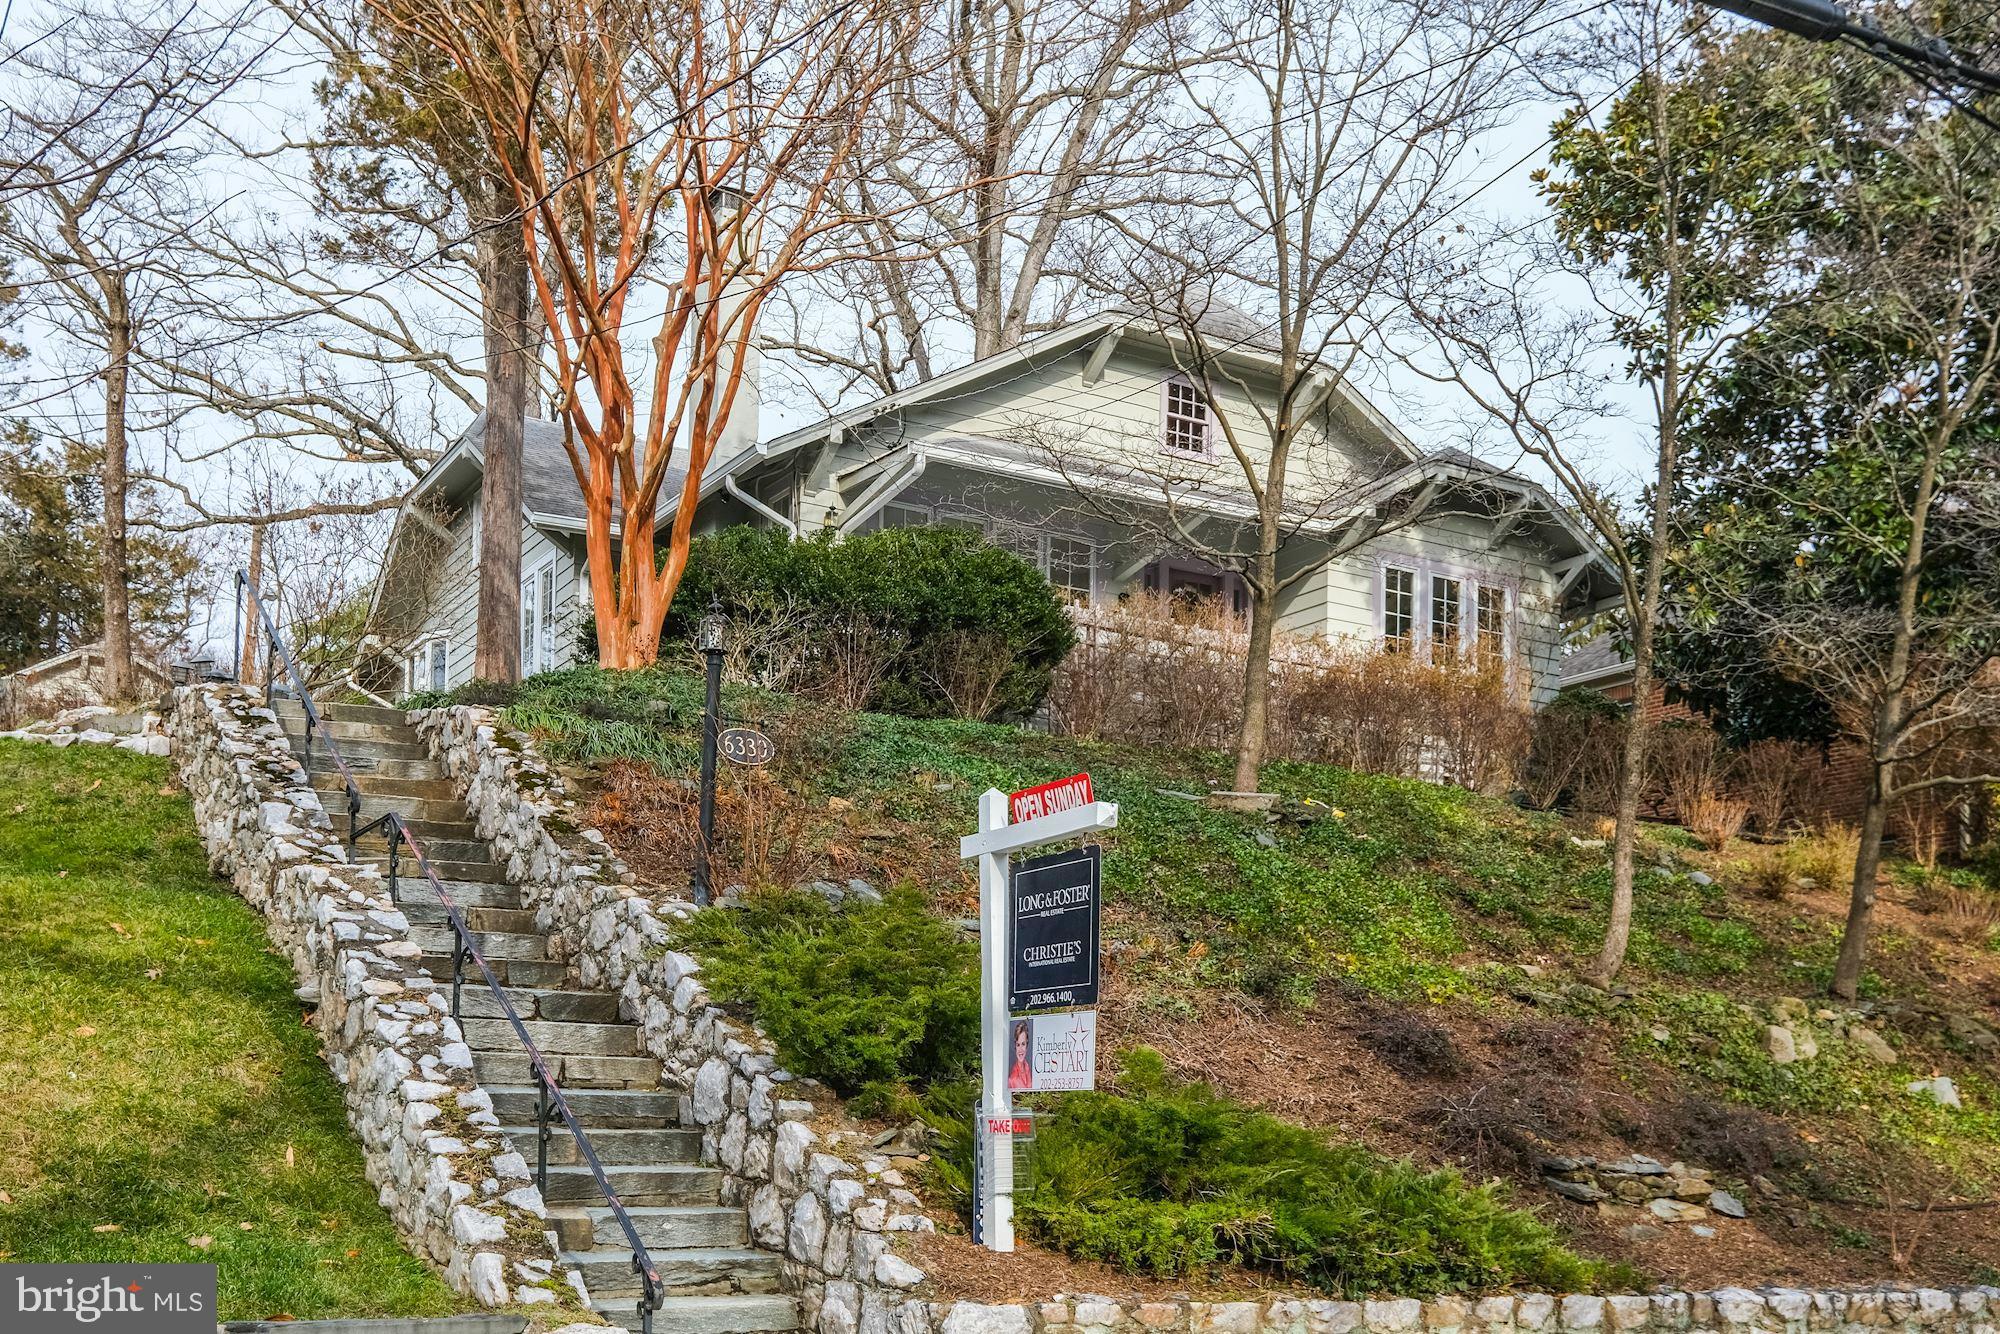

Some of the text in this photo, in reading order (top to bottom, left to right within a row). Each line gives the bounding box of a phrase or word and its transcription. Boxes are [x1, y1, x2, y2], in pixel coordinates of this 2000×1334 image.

[1014, 780, 1088, 823] OPEN SUNDAY
[1023, 940, 1081, 962] CHRISTIE'S
[1030, 991, 1072, 1005] 202.966.1400
[1036, 1032, 1073, 1052] Kimberly
[1034, 1050, 1088, 1074] CESTARI
[1040, 1077, 1083, 1089] 202-253-8757
[988, 1119, 1010, 1133] TAKE
